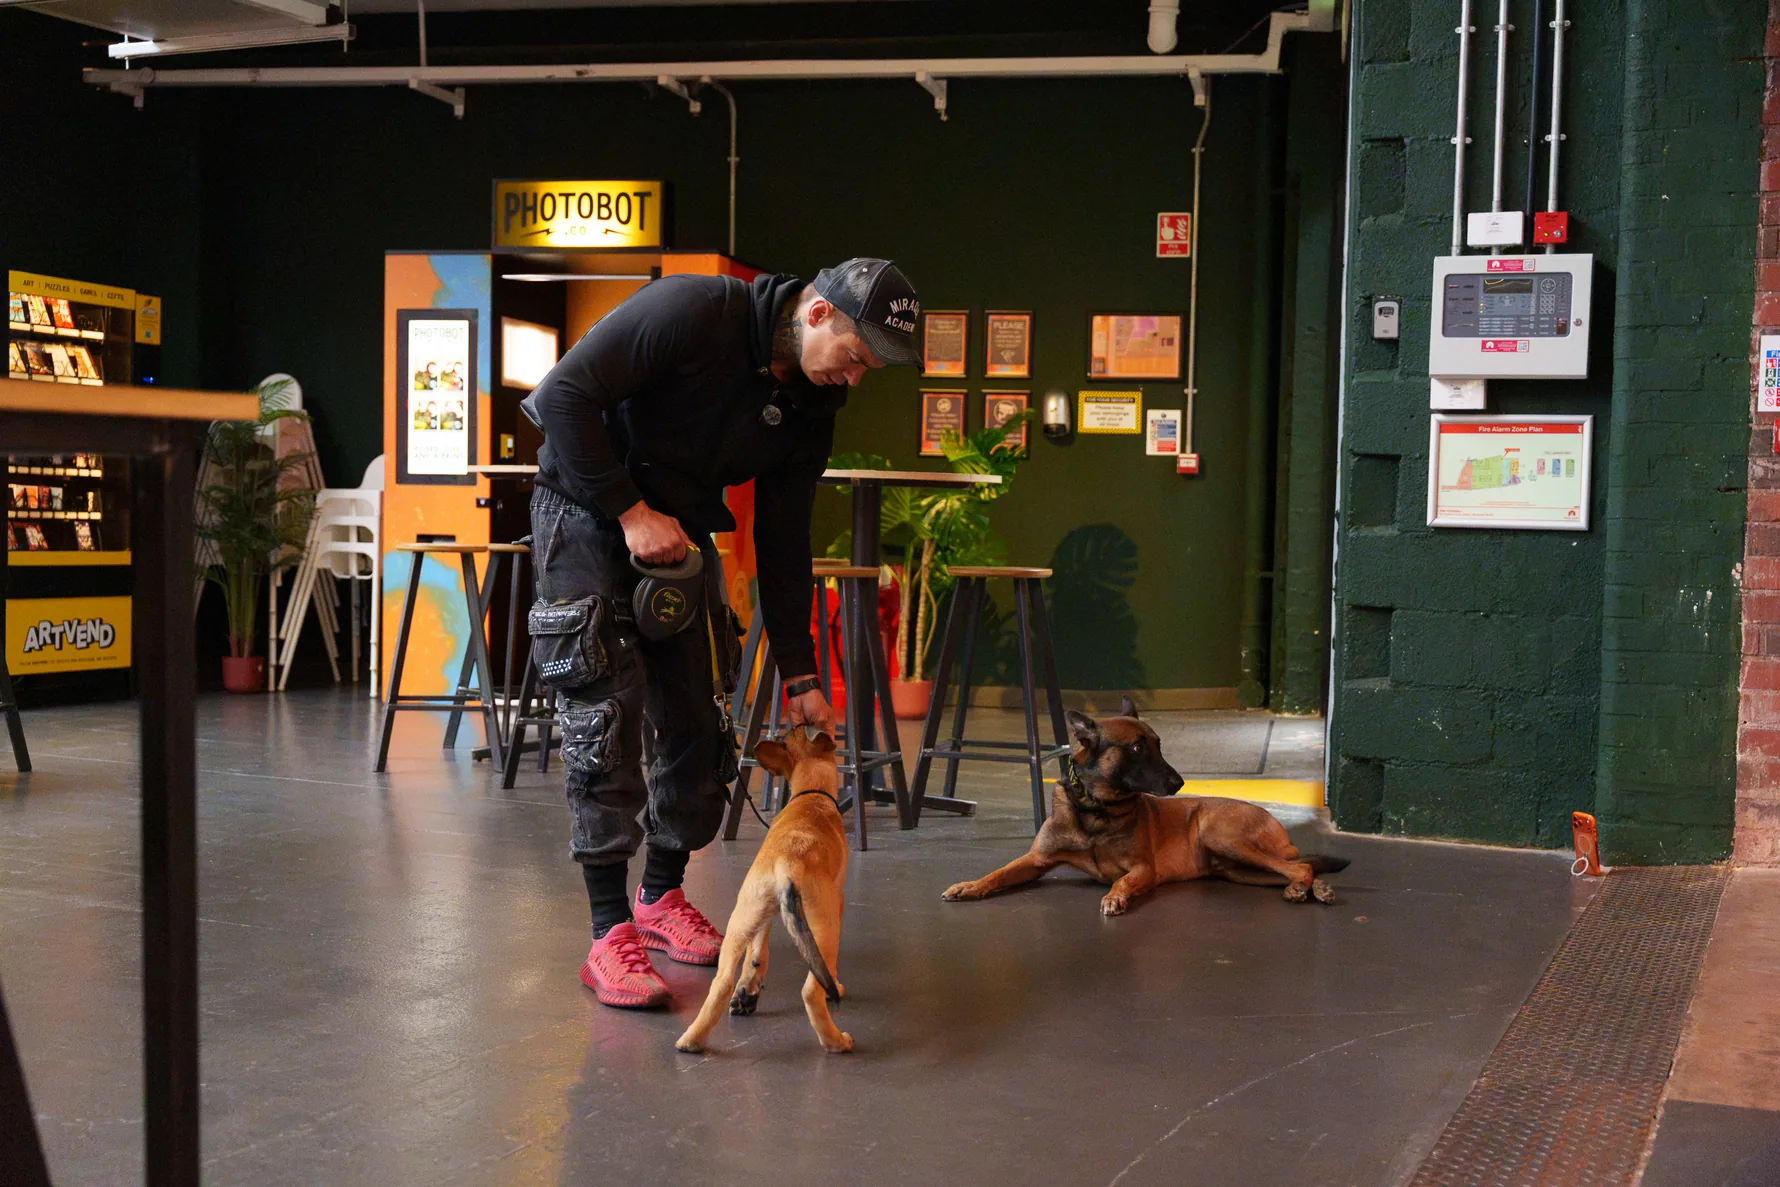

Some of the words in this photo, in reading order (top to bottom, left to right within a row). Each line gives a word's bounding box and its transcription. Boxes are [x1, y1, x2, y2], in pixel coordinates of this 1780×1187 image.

[504, 191, 652, 235] PHOTOBOT
[22, 279, 35, 287] ART
[44, 282, 70, 293] PUZZLES
[79, 287, 98, 297] GAMES
[106, 292, 125, 302] GIFTS
[993, 321, 1025, 330] PLEASE
[1478, 425, 1491, 433] Fire
[1491, 425, 1511, 433] Alarm
[1511, 425, 1528, 433] Zone
[1528, 425, 1544, 433] Plan
[23, 617, 115, 653] ARTVEND
